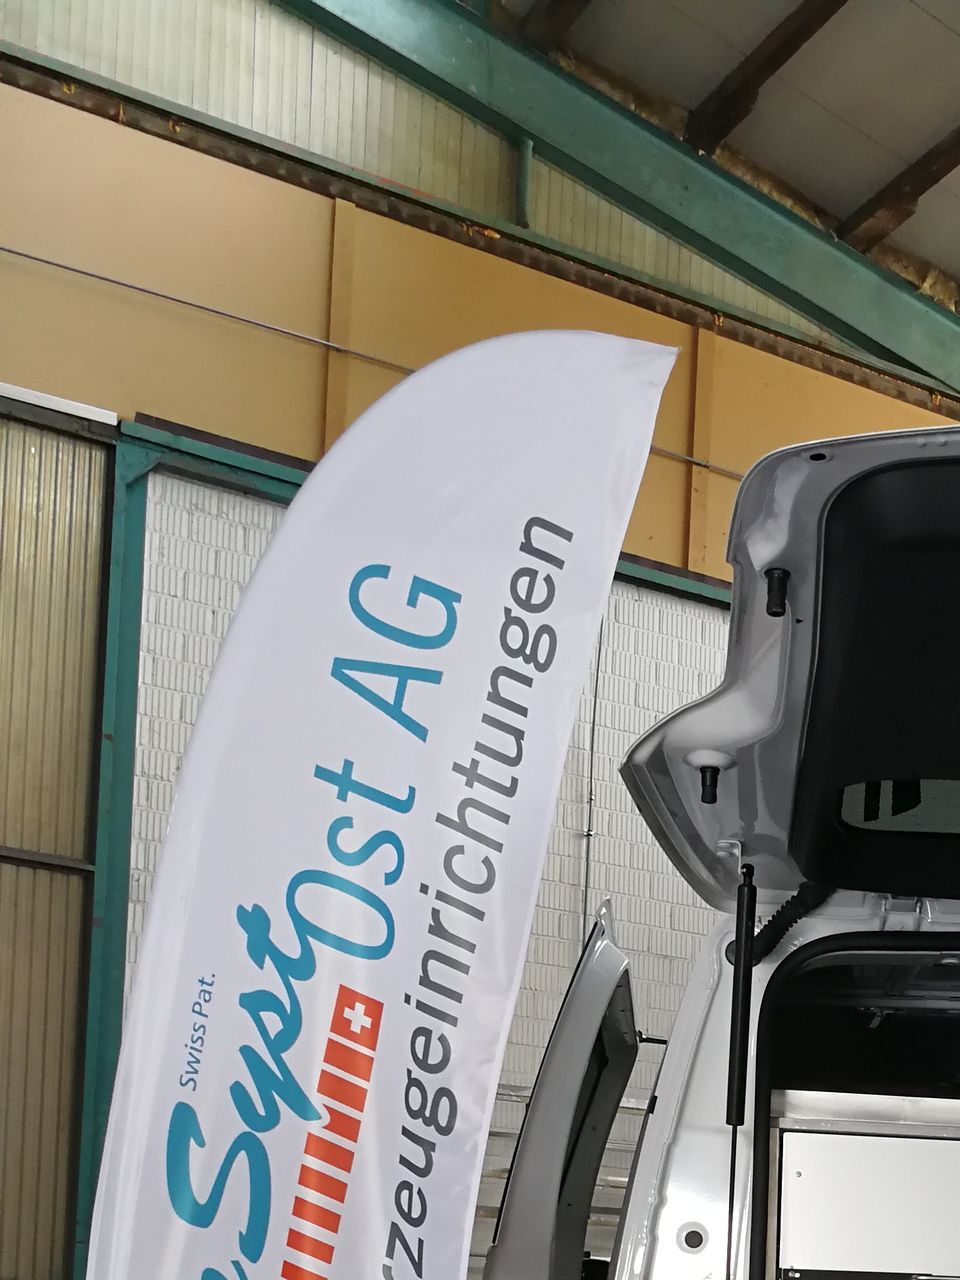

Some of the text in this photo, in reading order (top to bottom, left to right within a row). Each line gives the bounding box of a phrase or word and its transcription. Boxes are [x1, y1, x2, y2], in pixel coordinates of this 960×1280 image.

[330, 564, 461, 742] AG
[179, 973, 216, 1092] Swiss Pat.
